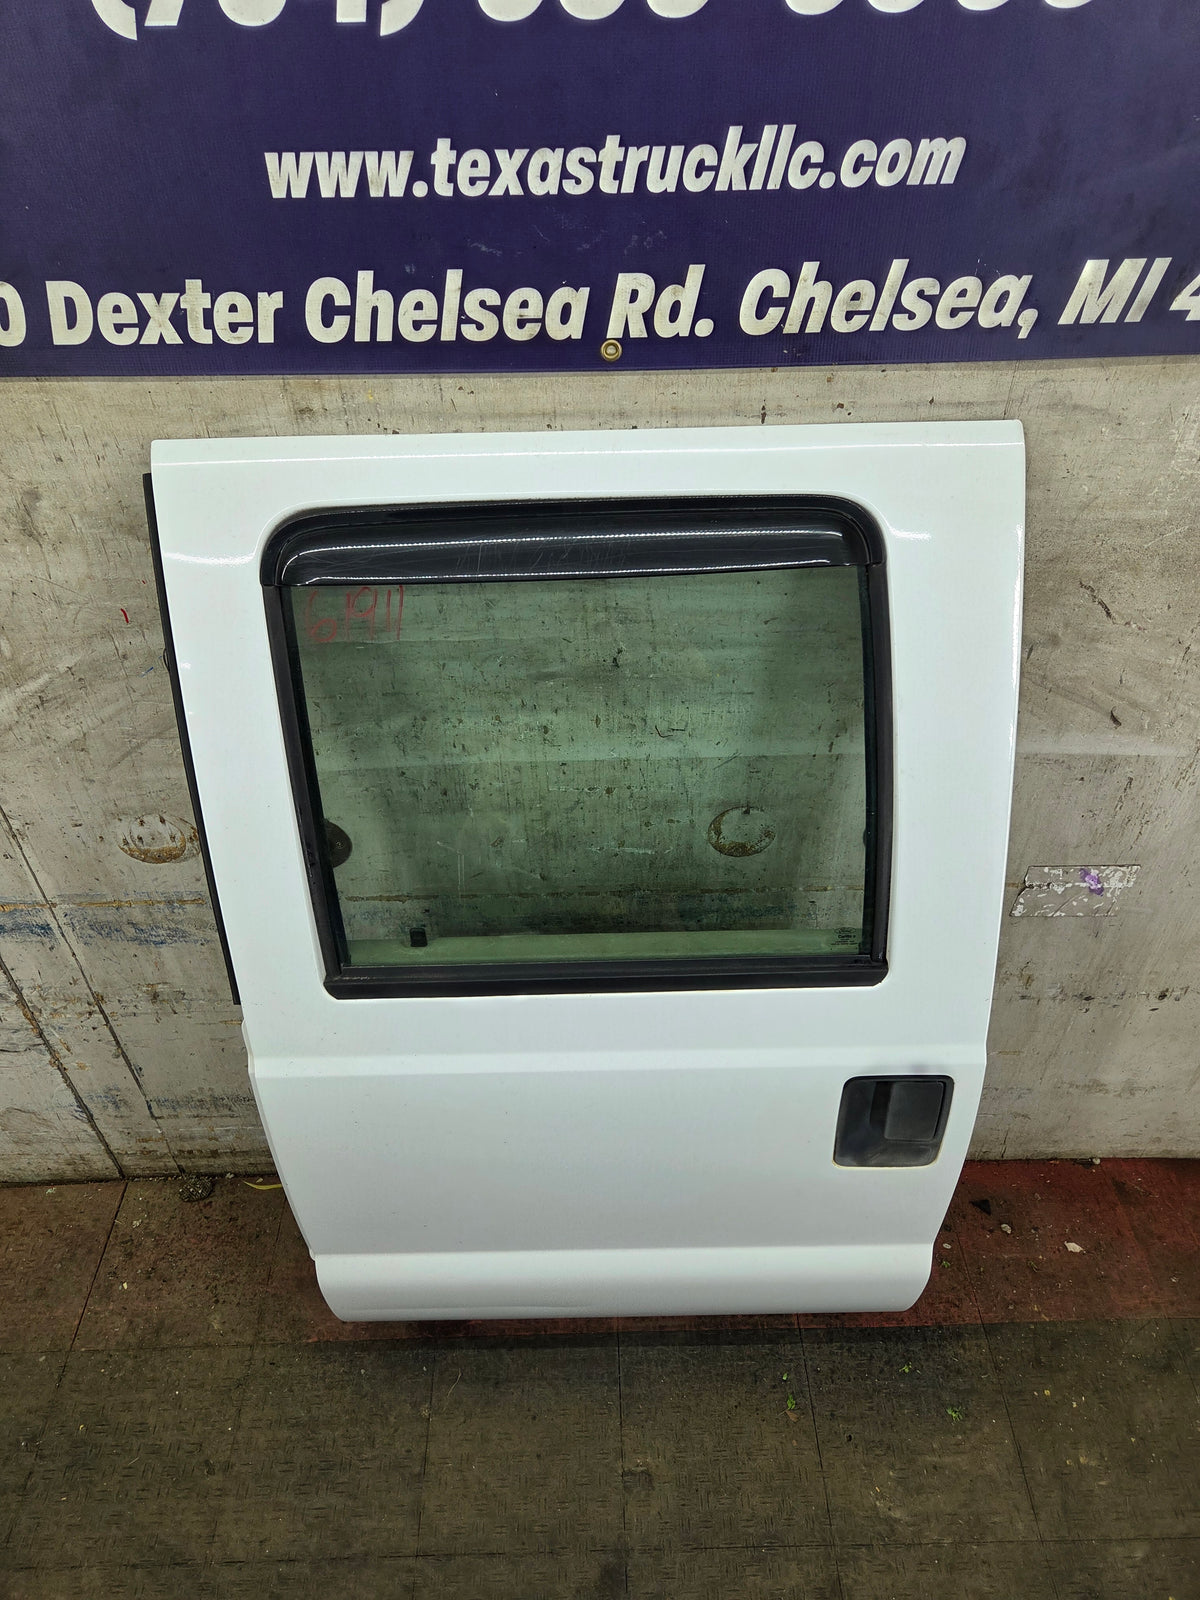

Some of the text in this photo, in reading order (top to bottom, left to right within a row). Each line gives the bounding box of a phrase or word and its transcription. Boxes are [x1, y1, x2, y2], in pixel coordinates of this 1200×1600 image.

[264, 124, 967, 199] www.texastruckllc.com
[45, 278, 284, 346] Dexter
[304, 268, 591, 343] Chelsea
[606, 263, 714, 338] Rd.
[739, 258, 1039, 339] Chelsea,
[1057, 256, 1173, 325] MI
